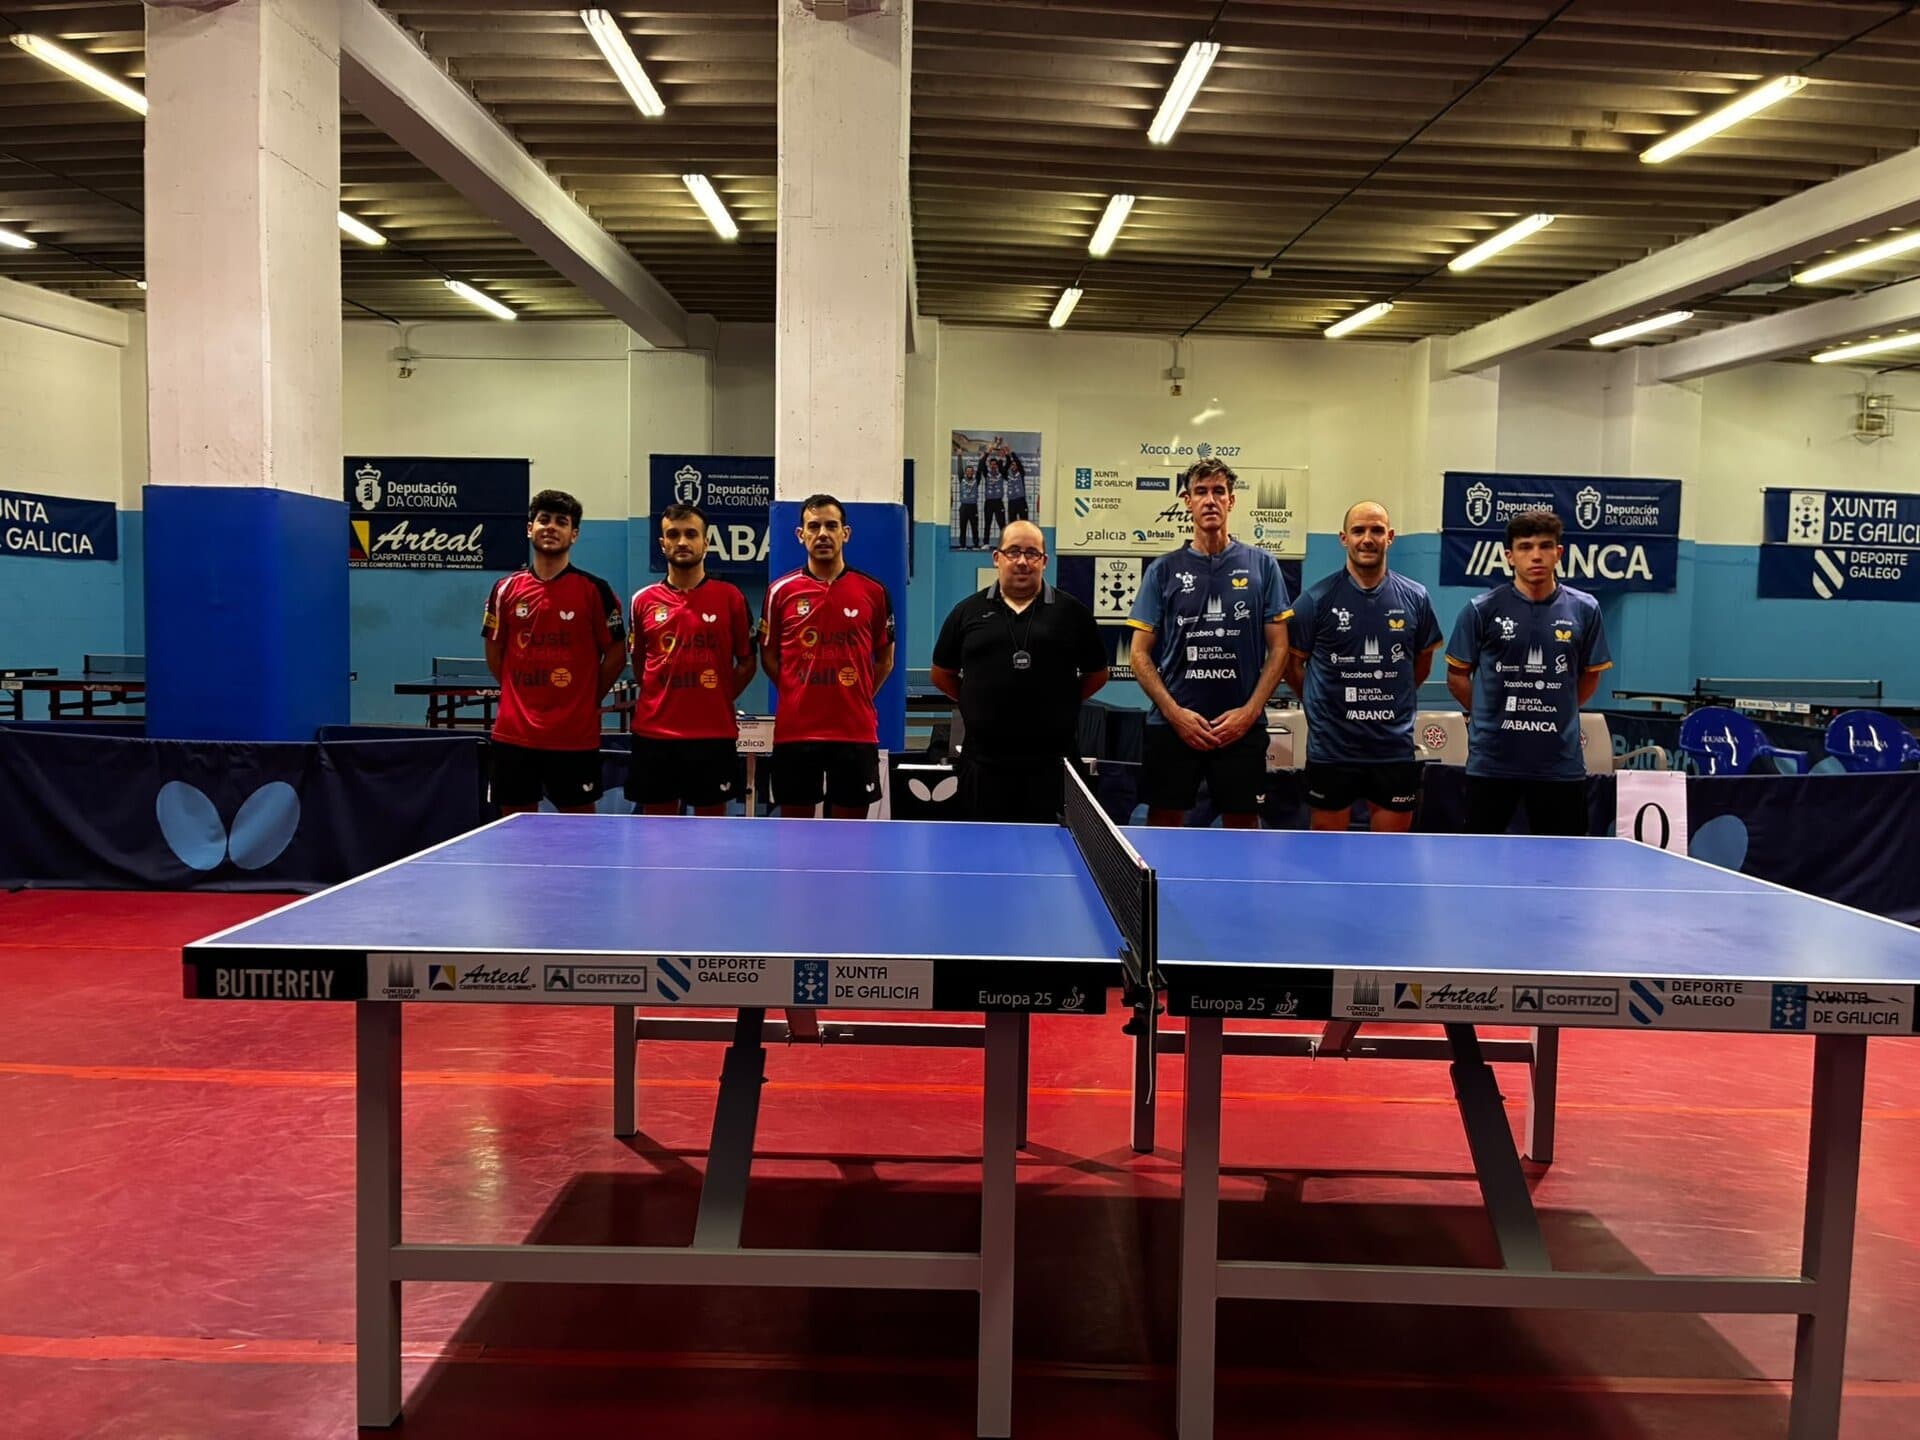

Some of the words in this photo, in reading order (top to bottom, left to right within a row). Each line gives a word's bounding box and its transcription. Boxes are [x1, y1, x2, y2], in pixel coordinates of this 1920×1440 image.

[1215, 446, 1240, 456] 2027
[387, 481, 457, 495] Deputación
[707, 483, 769, 497] Deputación
[387, 496, 405, 508] DA
[406, 494, 457, 508] CORUÑA
[707, 495, 722, 505] DA
[725, 495, 769, 506] CORUÑA
[1496, 501, 1553, 513] Deputación
[0, 498, 49, 524] NTA
[1155, 503, 1193, 523] Art
[1605, 504, 1659, 517] Deputación
[1830, 497, 1897, 519] XUNTA
[1496, 512, 1509, 522] DA
[1605, 515, 1618, 525] DA
[1619, 514, 1659, 526] CORUÑA
[371, 520, 484, 552] Arteal
[1084, 529, 1126, 542] galicia
[1829, 521, 1855, 541] DE
[6, 527, 94, 555] GALICIA
[372, 553, 427, 561] CARPINTEROS
[1851, 551, 1908, 565] DEPORTE
[1850, 566, 1901, 579] GALEGO
[1340, 671, 1373, 679] Xacobeo
[1634, 802, 1669, 850] 0
[697, 958, 766, 970] DEPORTE
[460, 964, 530, 984] Arteal
[576, 973, 640, 985] CORTIZO
[697, 971, 759, 983] GALEGO
[835, 965, 888, 980] XUNTA
[216, 968, 334, 998] BUTTERFLY
[1672, 981, 1743, 993] DEPORTE
[835, 985, 854, 998] DE
[857, 986, 919, 1000] GALICIA
[978, 990, 1030, 1008] Europa
[1034, 992, 1052, 1006] 25
[1425, 983, 1498, 1004] Arteal
[1815, 990, 1868, 1004] XUNTA
[1191, 995, 1243, 1013] Europa
[1247, 997, 1265, 1011] 25
[1546, 993, 1613, 1007] CORTIZO
[1672, 994, 1735, 1007] GALEGO
[1813, 1011, 1832, 1024] DE
[1836, 1012, 1899, 1025] GALICIA
